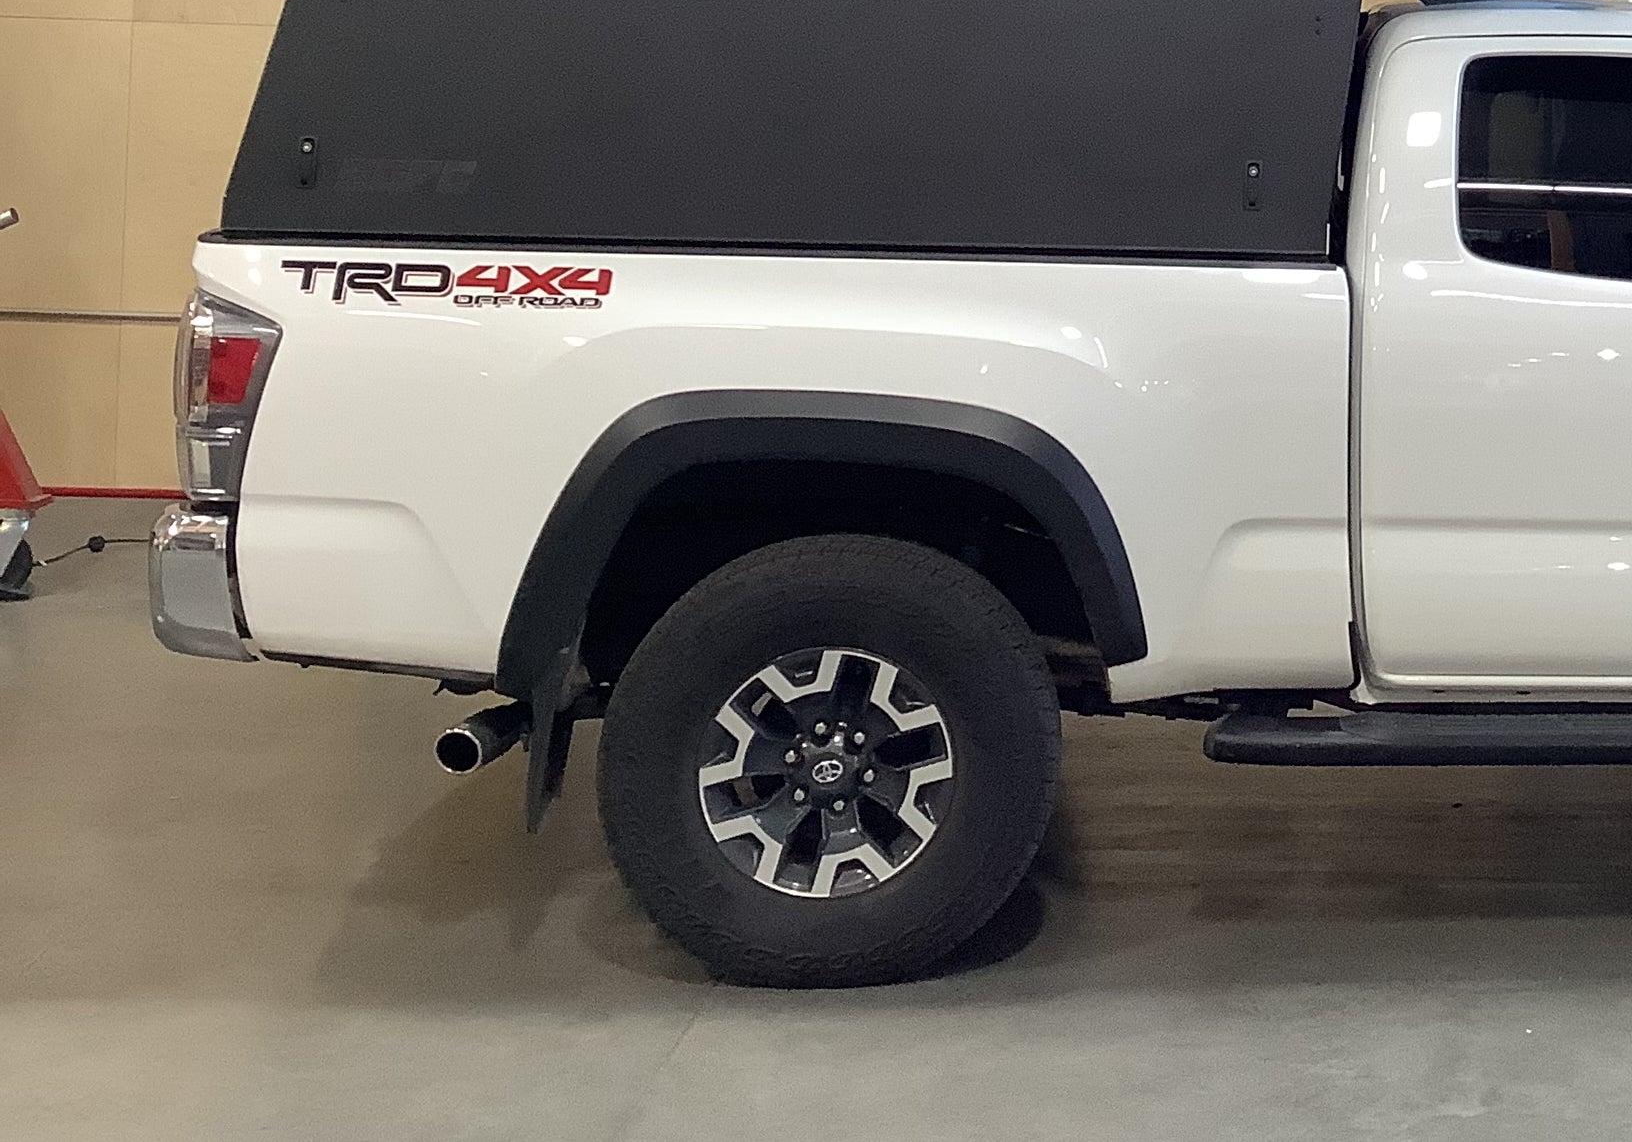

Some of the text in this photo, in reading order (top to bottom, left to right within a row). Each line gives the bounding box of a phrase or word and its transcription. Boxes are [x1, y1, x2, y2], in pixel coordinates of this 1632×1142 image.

[281, 260, 454, 305] TRD
[453, 294, 602, 308] OFF ROAD
